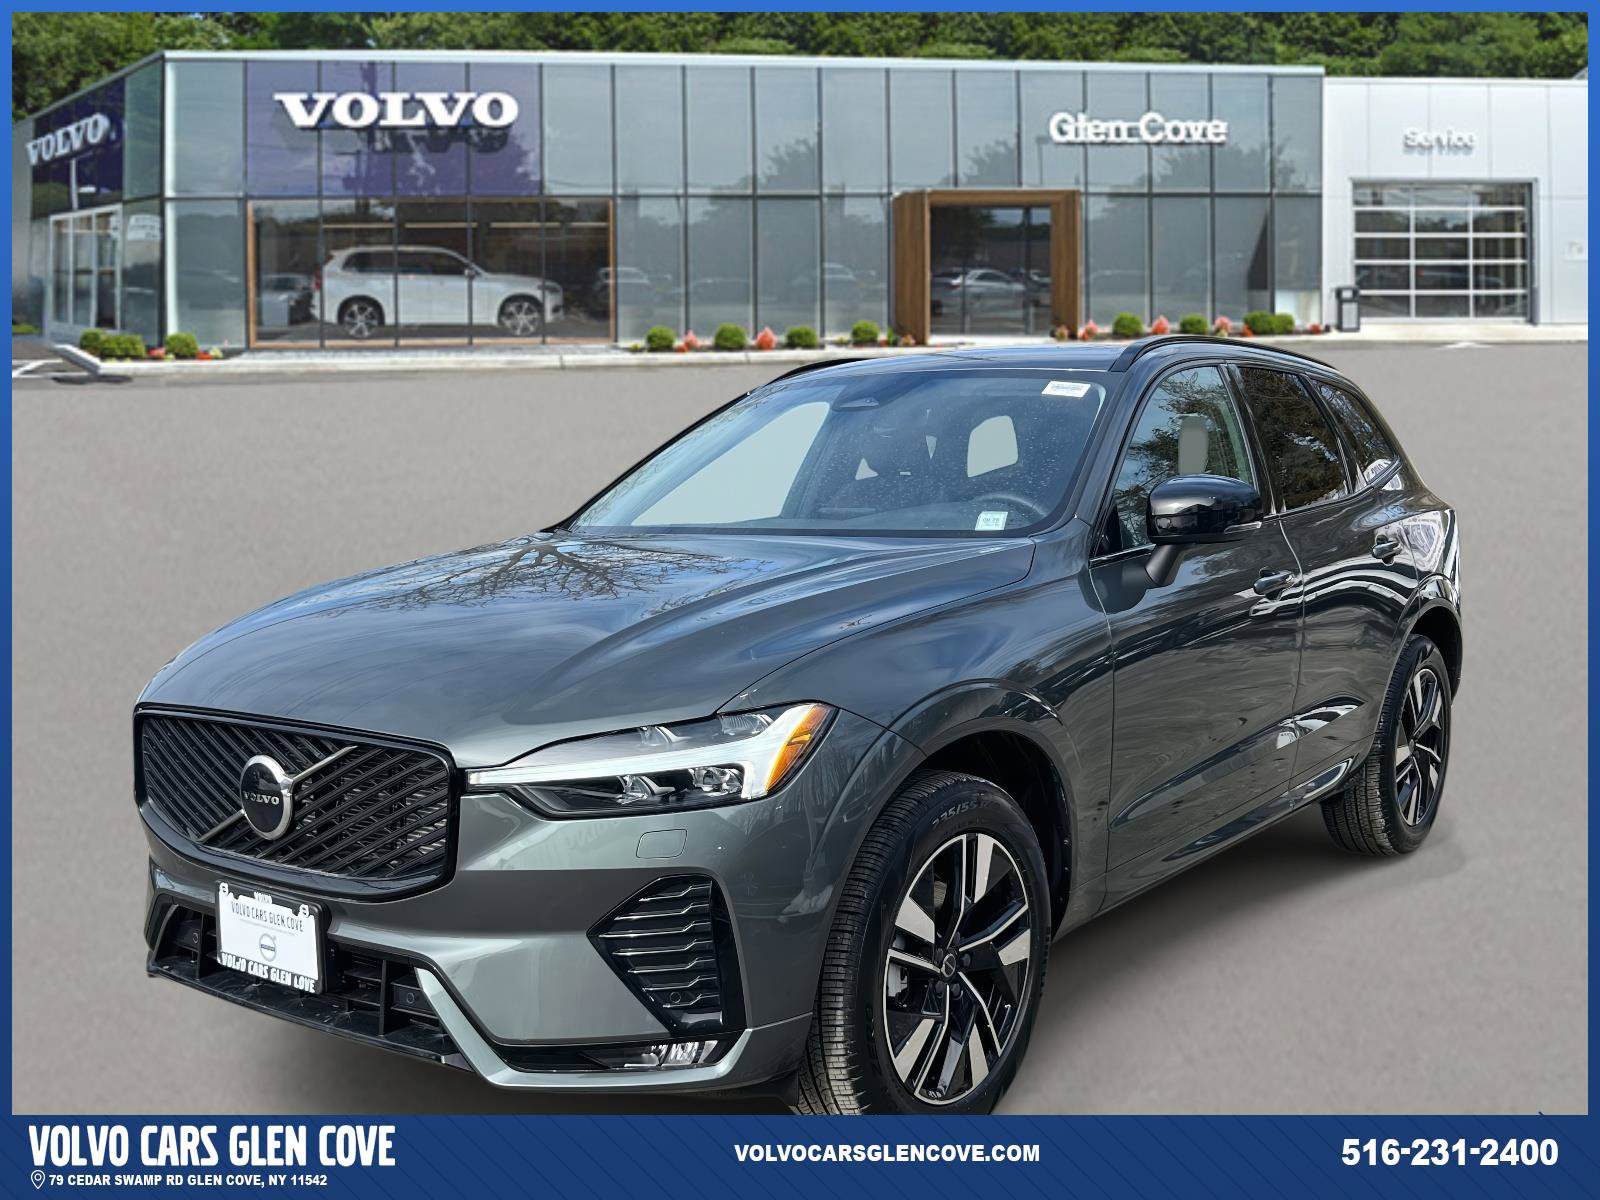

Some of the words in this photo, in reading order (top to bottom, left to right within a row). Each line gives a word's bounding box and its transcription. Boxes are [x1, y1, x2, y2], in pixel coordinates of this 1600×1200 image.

[273, 92, 519, 127] VOLVO
[25, 113, 109, 165] VOLVO
[1049, 112, 1130, 143] Glen
[1139, 112, 1228, 143] Cove
[1403, 128, 1474, 152] Service
[243, 791, 280, 805] VOLVO
[231, 902, 251, 918] VOLVO
[251, 907, 268, 922] CARS
[269, 912, 286, 927] GLEN
[287, 917, 304, 932] COVE
[222, 953, 247, 972] VOLVO
[247, 961, 269, 979] CARS
[270, 968, 292, 986] GLEN
